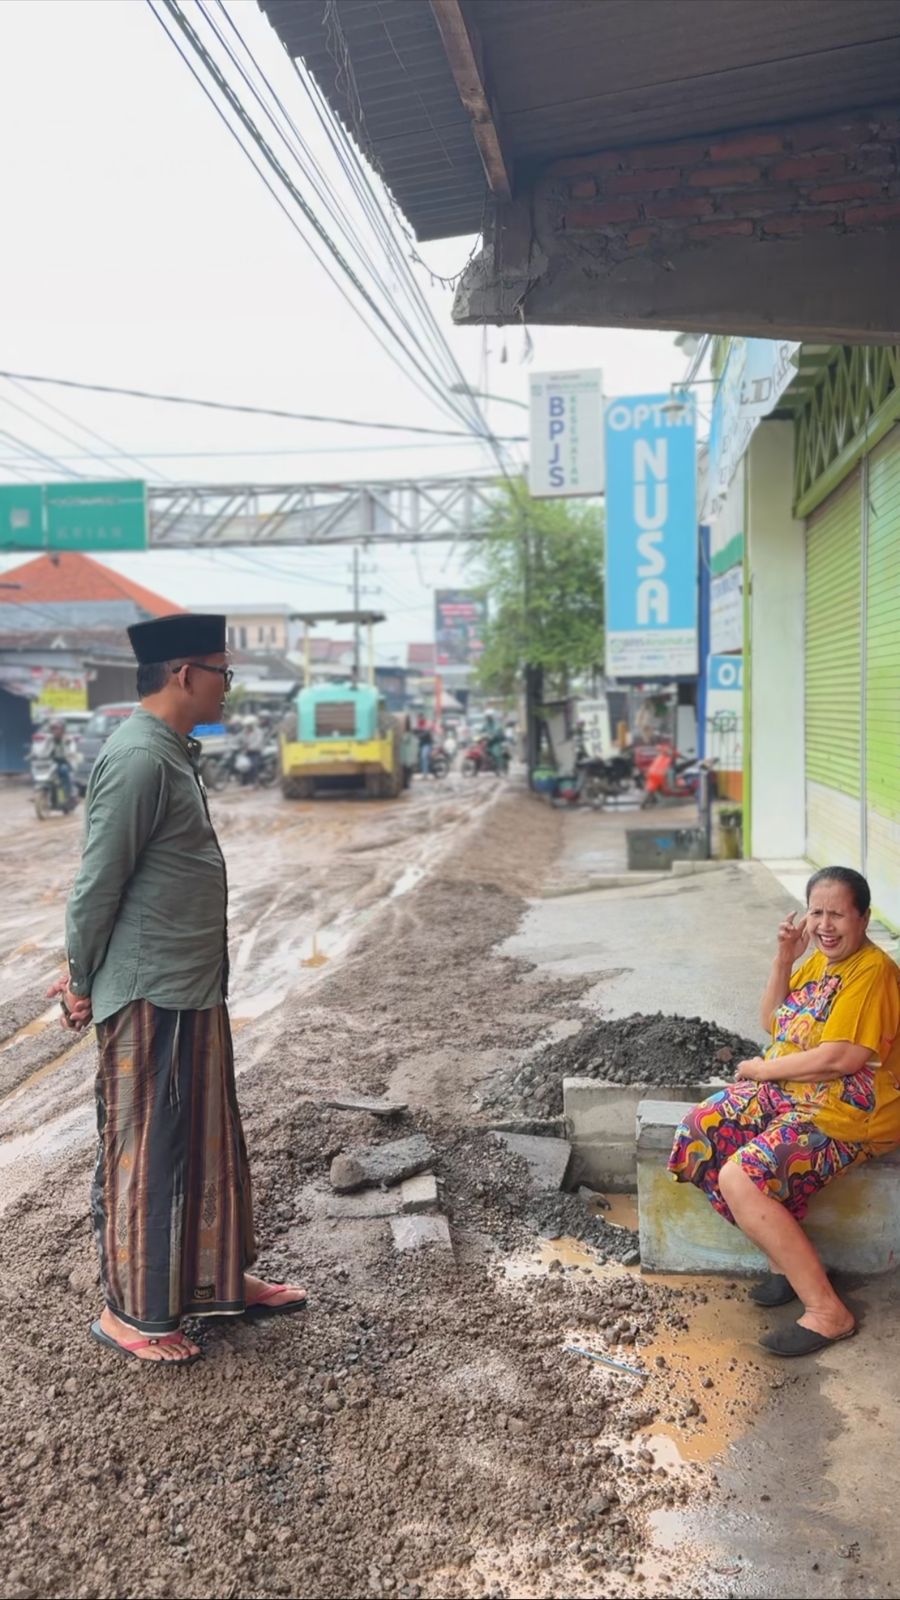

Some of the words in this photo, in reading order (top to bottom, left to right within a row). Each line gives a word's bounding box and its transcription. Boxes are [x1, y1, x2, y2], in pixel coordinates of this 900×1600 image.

[549, 396, 565, 488] BPJS
[633, 437, 669, 625] NUSA
[717, 662, 743, 687] O
